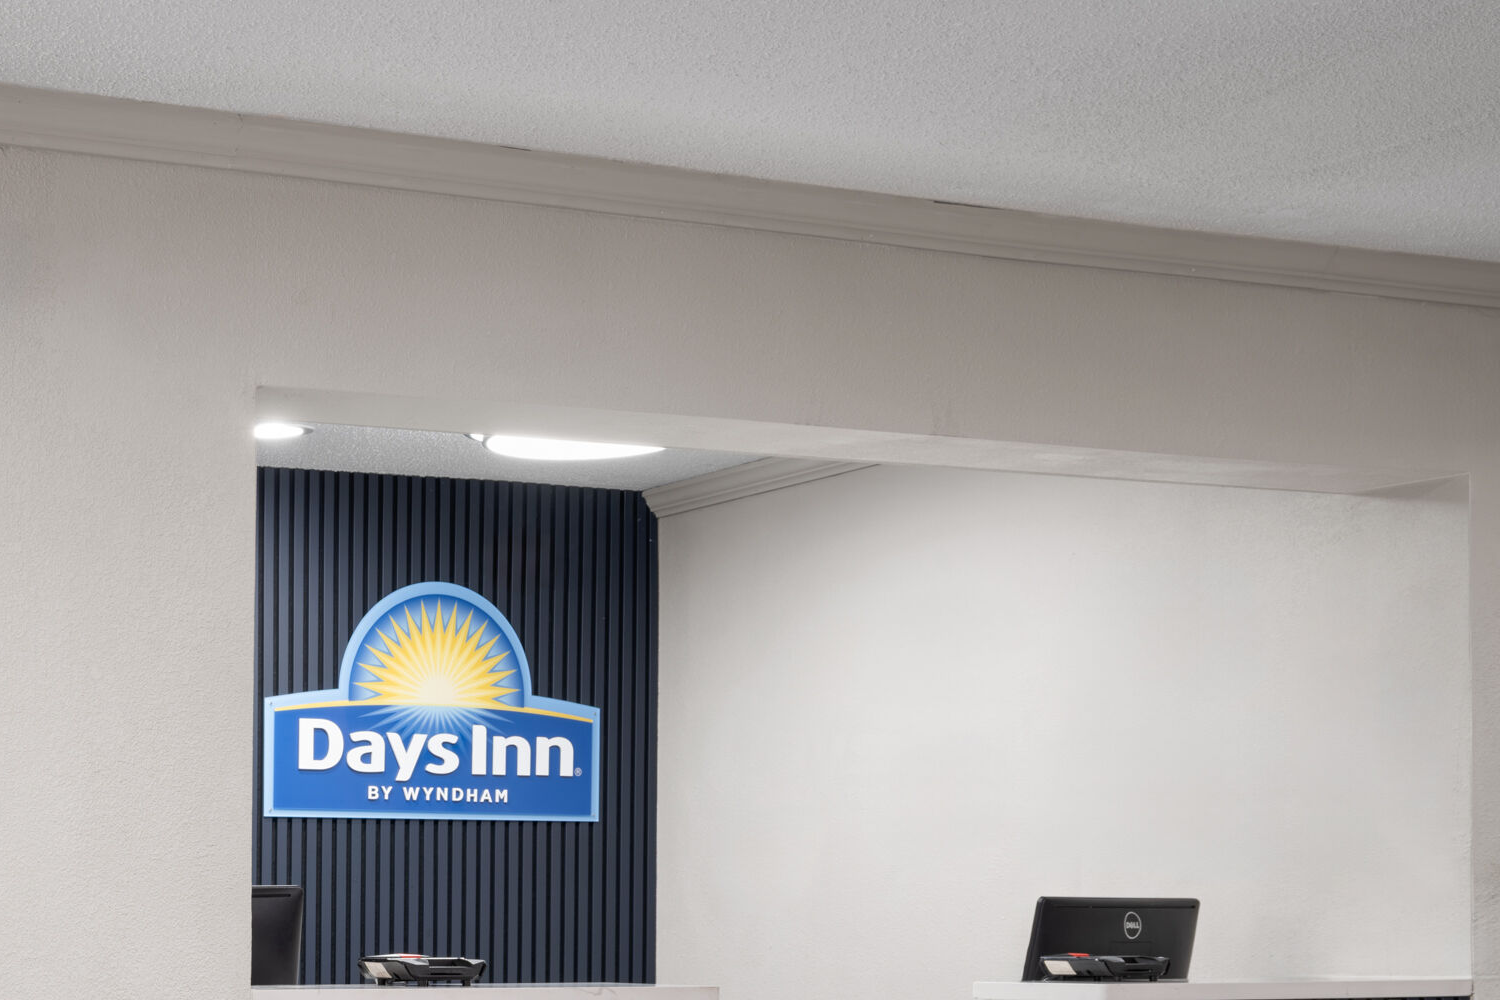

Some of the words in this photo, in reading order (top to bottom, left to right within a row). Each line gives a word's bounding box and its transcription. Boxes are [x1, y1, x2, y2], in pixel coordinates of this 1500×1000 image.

[298, 718, 460, 782] Days
[367, 785, 393, 801] BY
[403, 786, 509, 803] WYNDHAM
